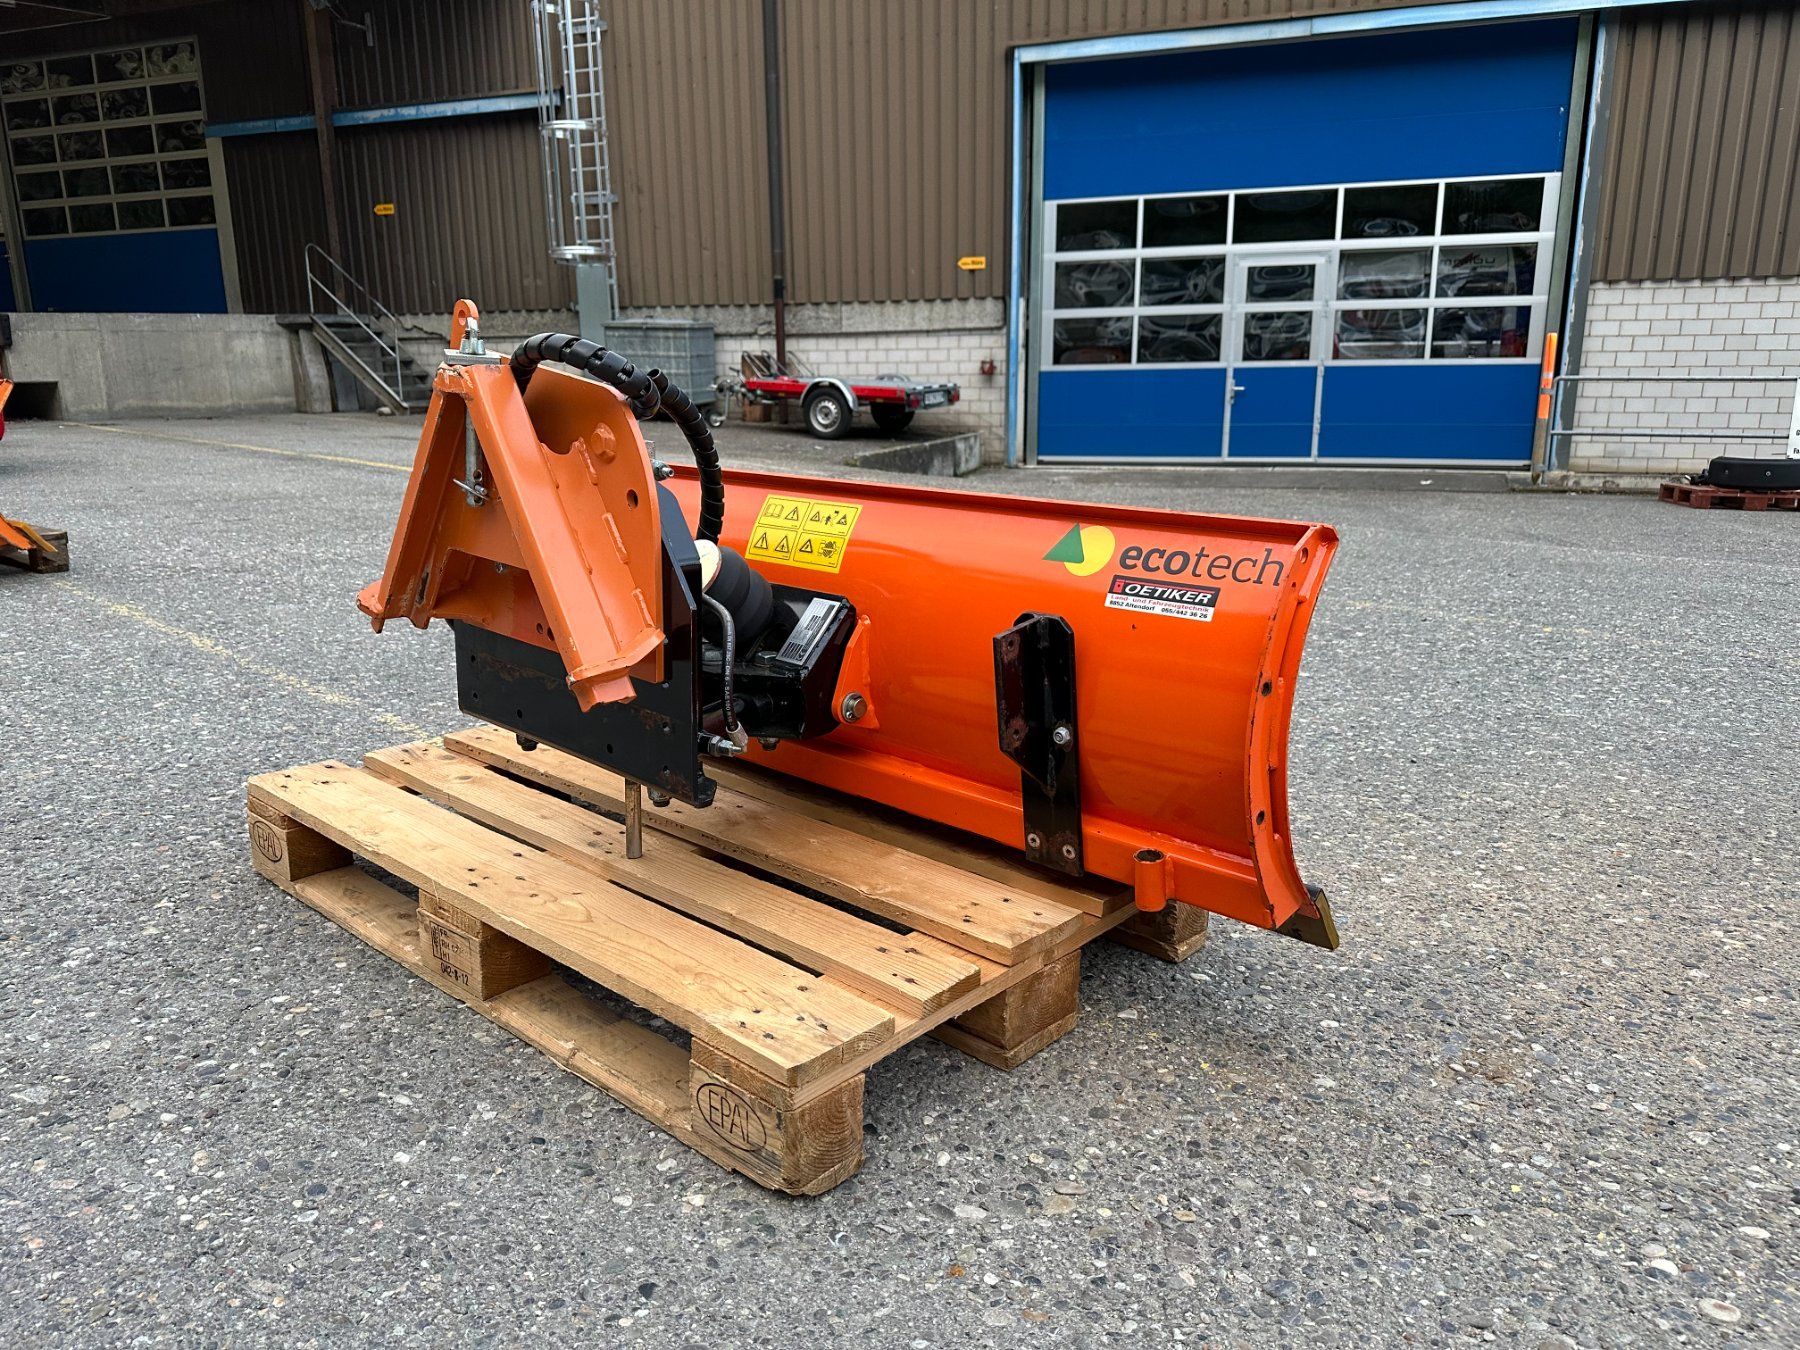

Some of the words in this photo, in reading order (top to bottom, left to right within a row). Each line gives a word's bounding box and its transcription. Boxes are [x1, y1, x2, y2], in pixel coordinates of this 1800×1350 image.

[1119, 545, 1284, 586] ecotech
[1124, 583, 1213, 604] OETIKER
[1125, 601, 1156, 611] Altendorf
[1148, 599, 1210, 613] Fahrzeugtechnik
[256, 825, 279, 859] EPAL
[708, 1089, 753, 1144] EPAL
